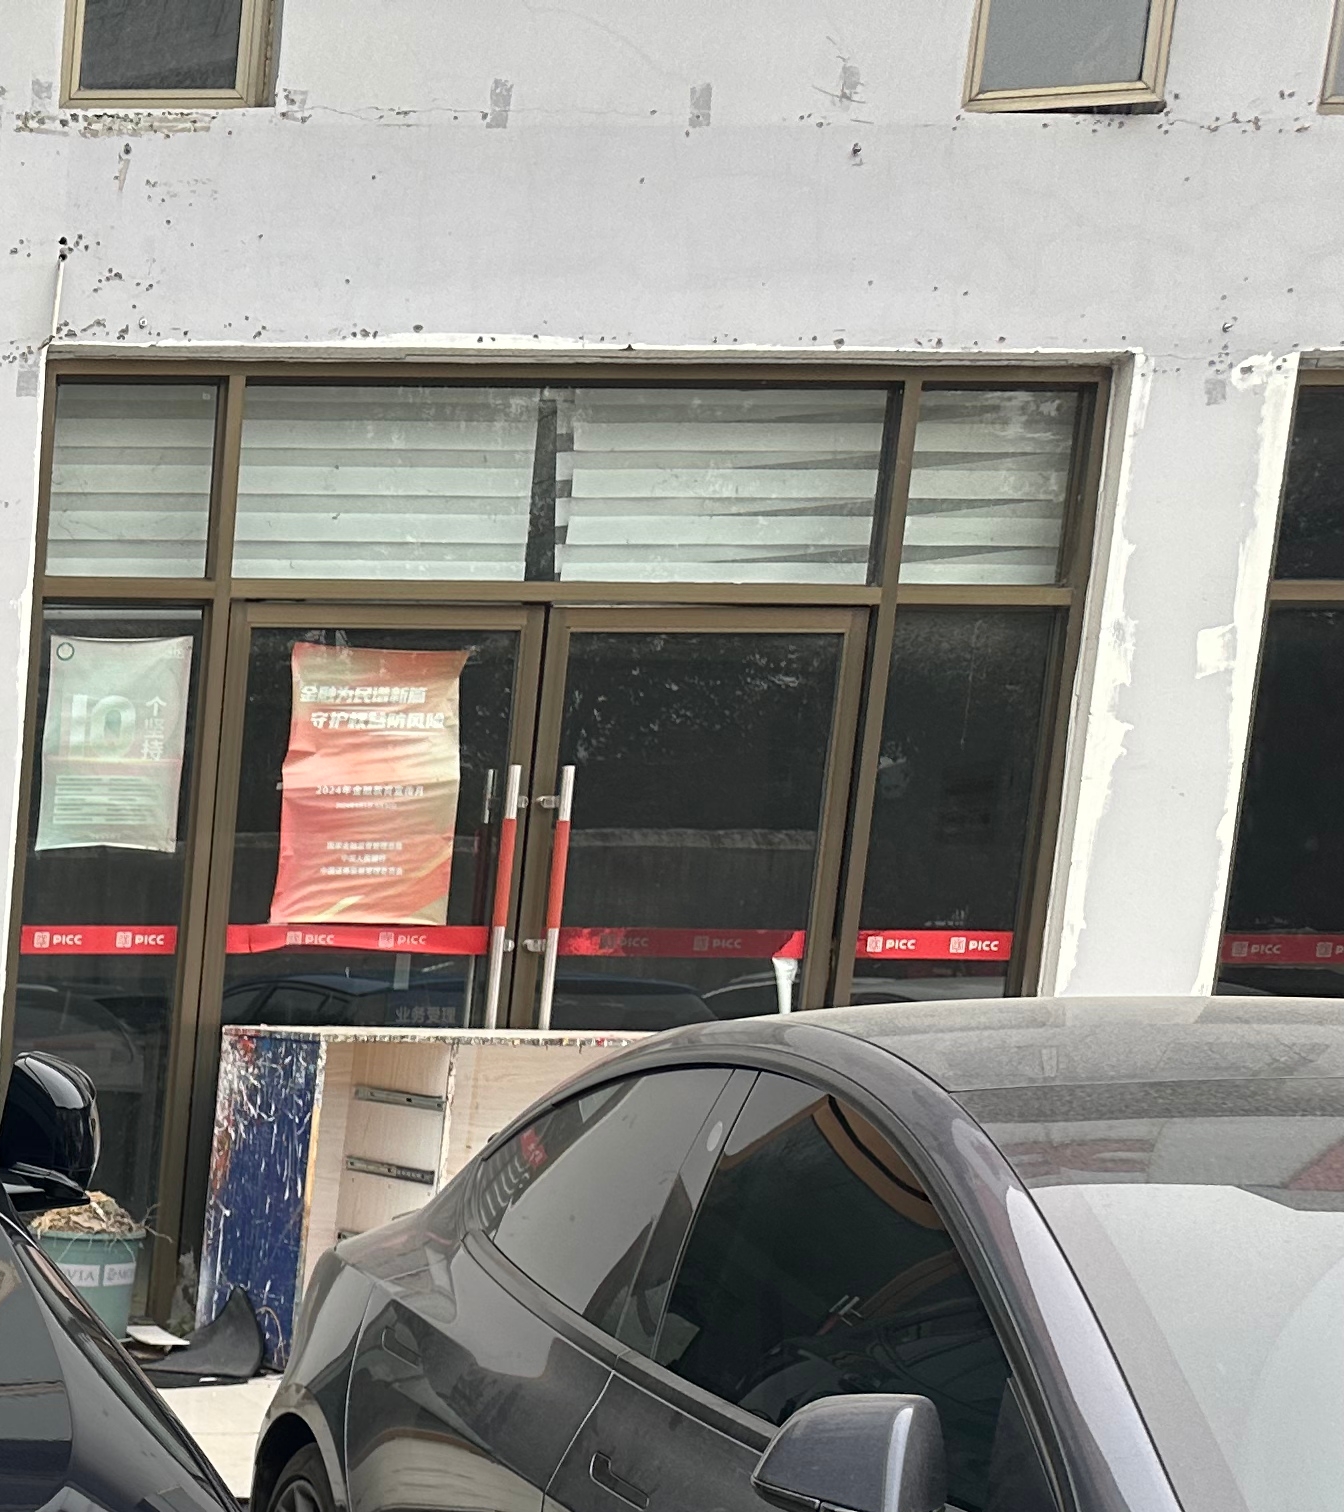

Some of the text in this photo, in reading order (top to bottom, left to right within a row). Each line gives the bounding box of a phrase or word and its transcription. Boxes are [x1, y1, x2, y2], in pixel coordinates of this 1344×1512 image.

[141, 696, 167, 761] 个坚持
[52, 934, 83, 945] PICC
[134, 934, 165, 945] PICC
[305, 934, 335, 945] PICC
[396, 934, 427, 945] PICC
[712, 939, 742, 948] PICC
[885, 939, 916, 950] PICC
[968, 940, 999, 951] PICC
[1250, 944, 1281, 954] PICC
[395, 1005, 456, 1023] 业务受理
